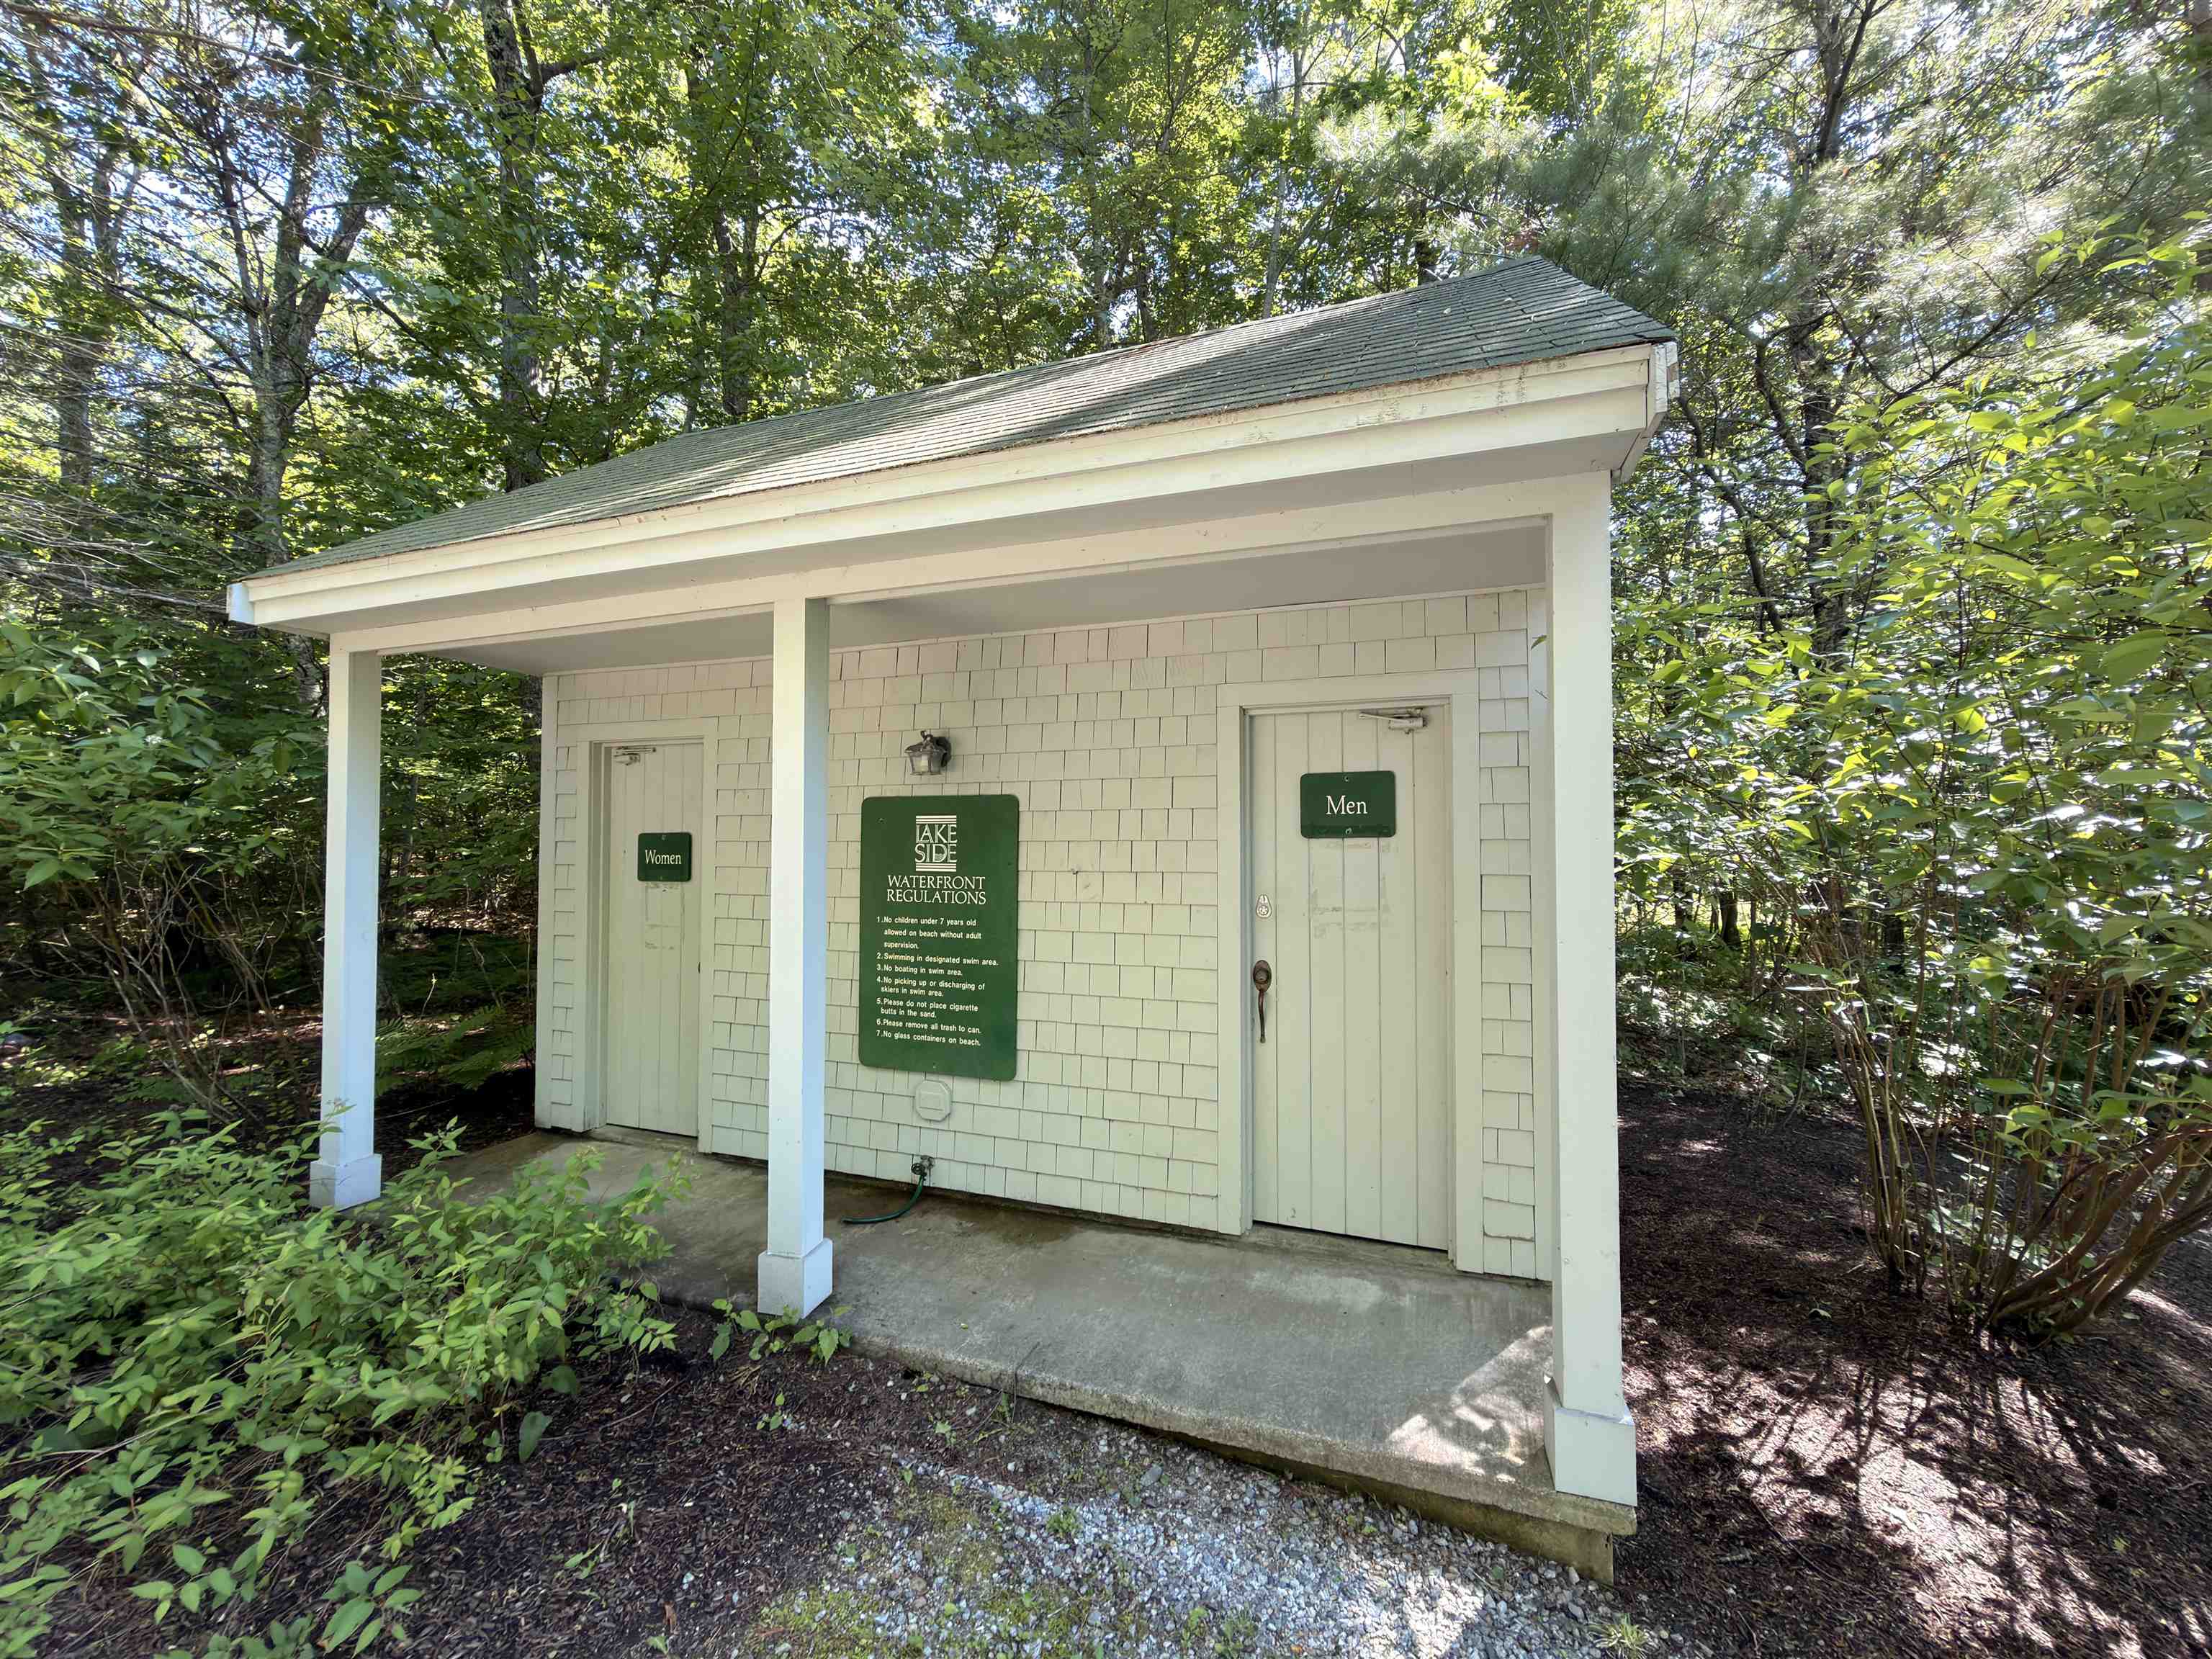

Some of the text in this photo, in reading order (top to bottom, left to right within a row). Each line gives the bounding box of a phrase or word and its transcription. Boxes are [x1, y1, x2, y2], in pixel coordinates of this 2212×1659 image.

[1326, 795, 1367, 814] Men
[916, 824, 957, 843] LAKE
[645, 850, 681, 864] Women
[915, 843, 957, 863] SIDE
[888, 875, 985, 889] WATERFRONT
[887, 889, 986, 904] REGULATIONS
[925, 956, 960, 964] designated
[895, 965, 917, 974] boating
[894, 978, 916, 986] picking
[939, 981, 975, 990] discharging
[913, 1033, 945, 1043] containers
